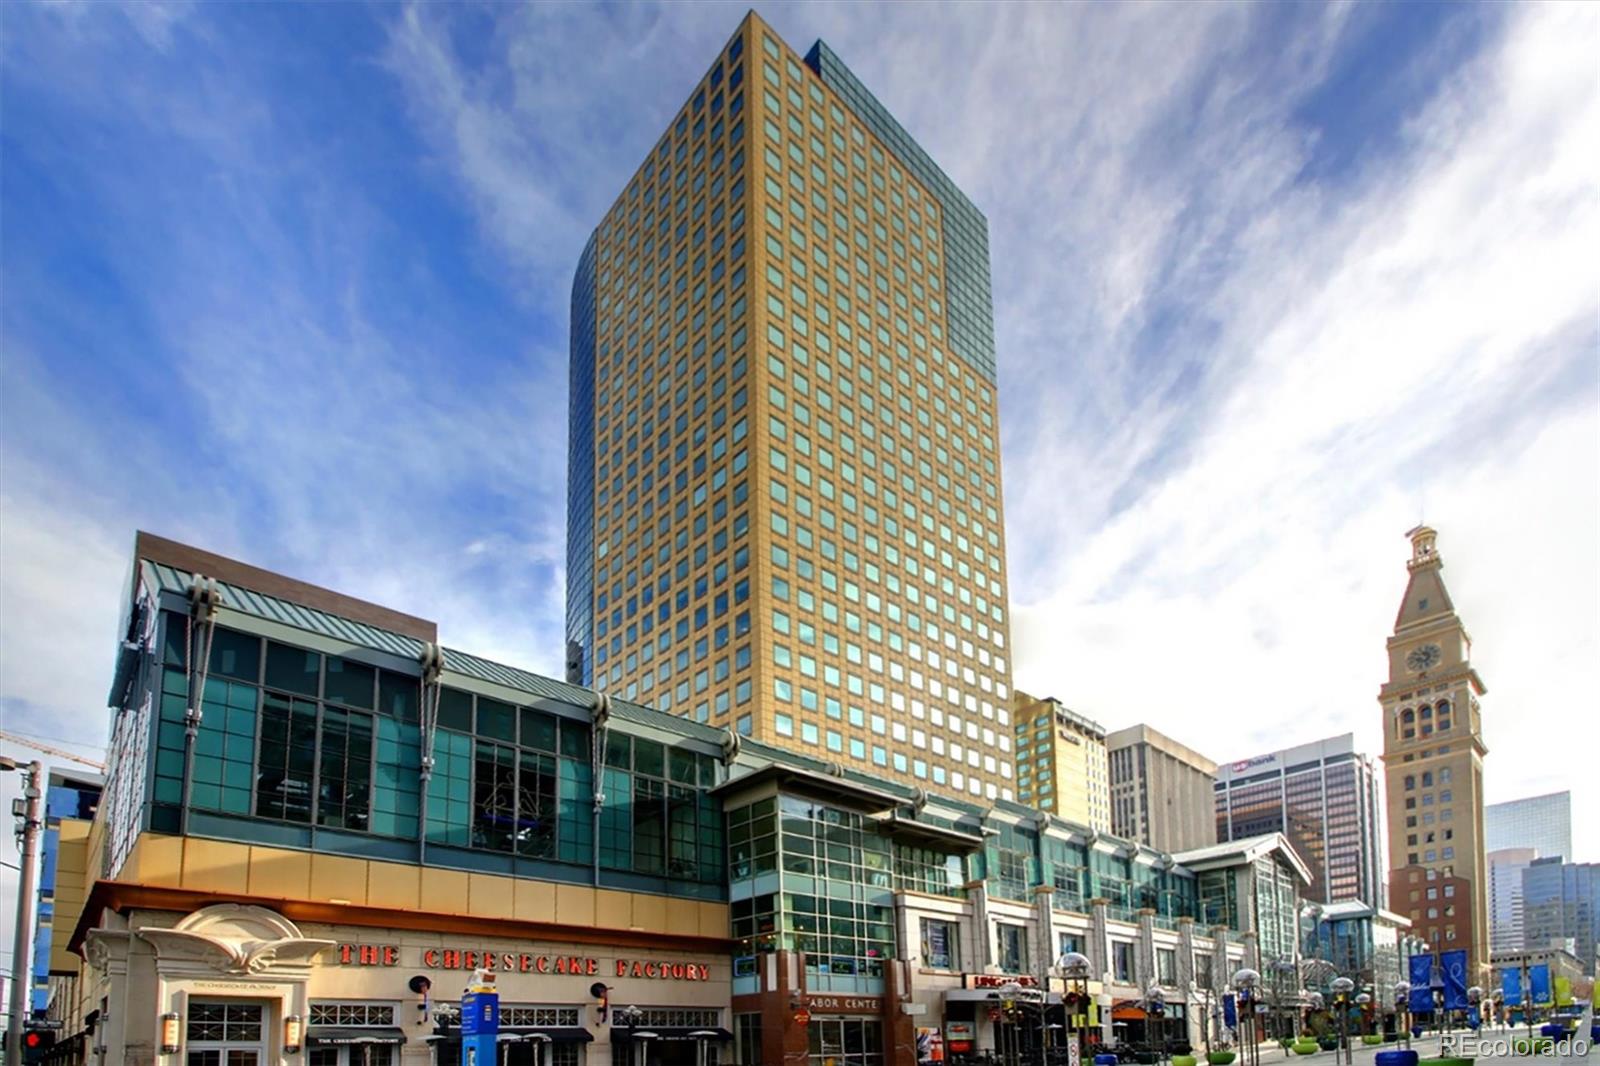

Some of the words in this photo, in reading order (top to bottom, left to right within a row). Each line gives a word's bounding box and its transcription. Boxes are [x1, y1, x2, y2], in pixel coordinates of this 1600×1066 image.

[338, 943, 400, 968] THE
[424, 948, 599, 977] CHEESECAKE
[616, 959, 710, 982] FACTORY
[844, 999, 881, 1010] CENTE
